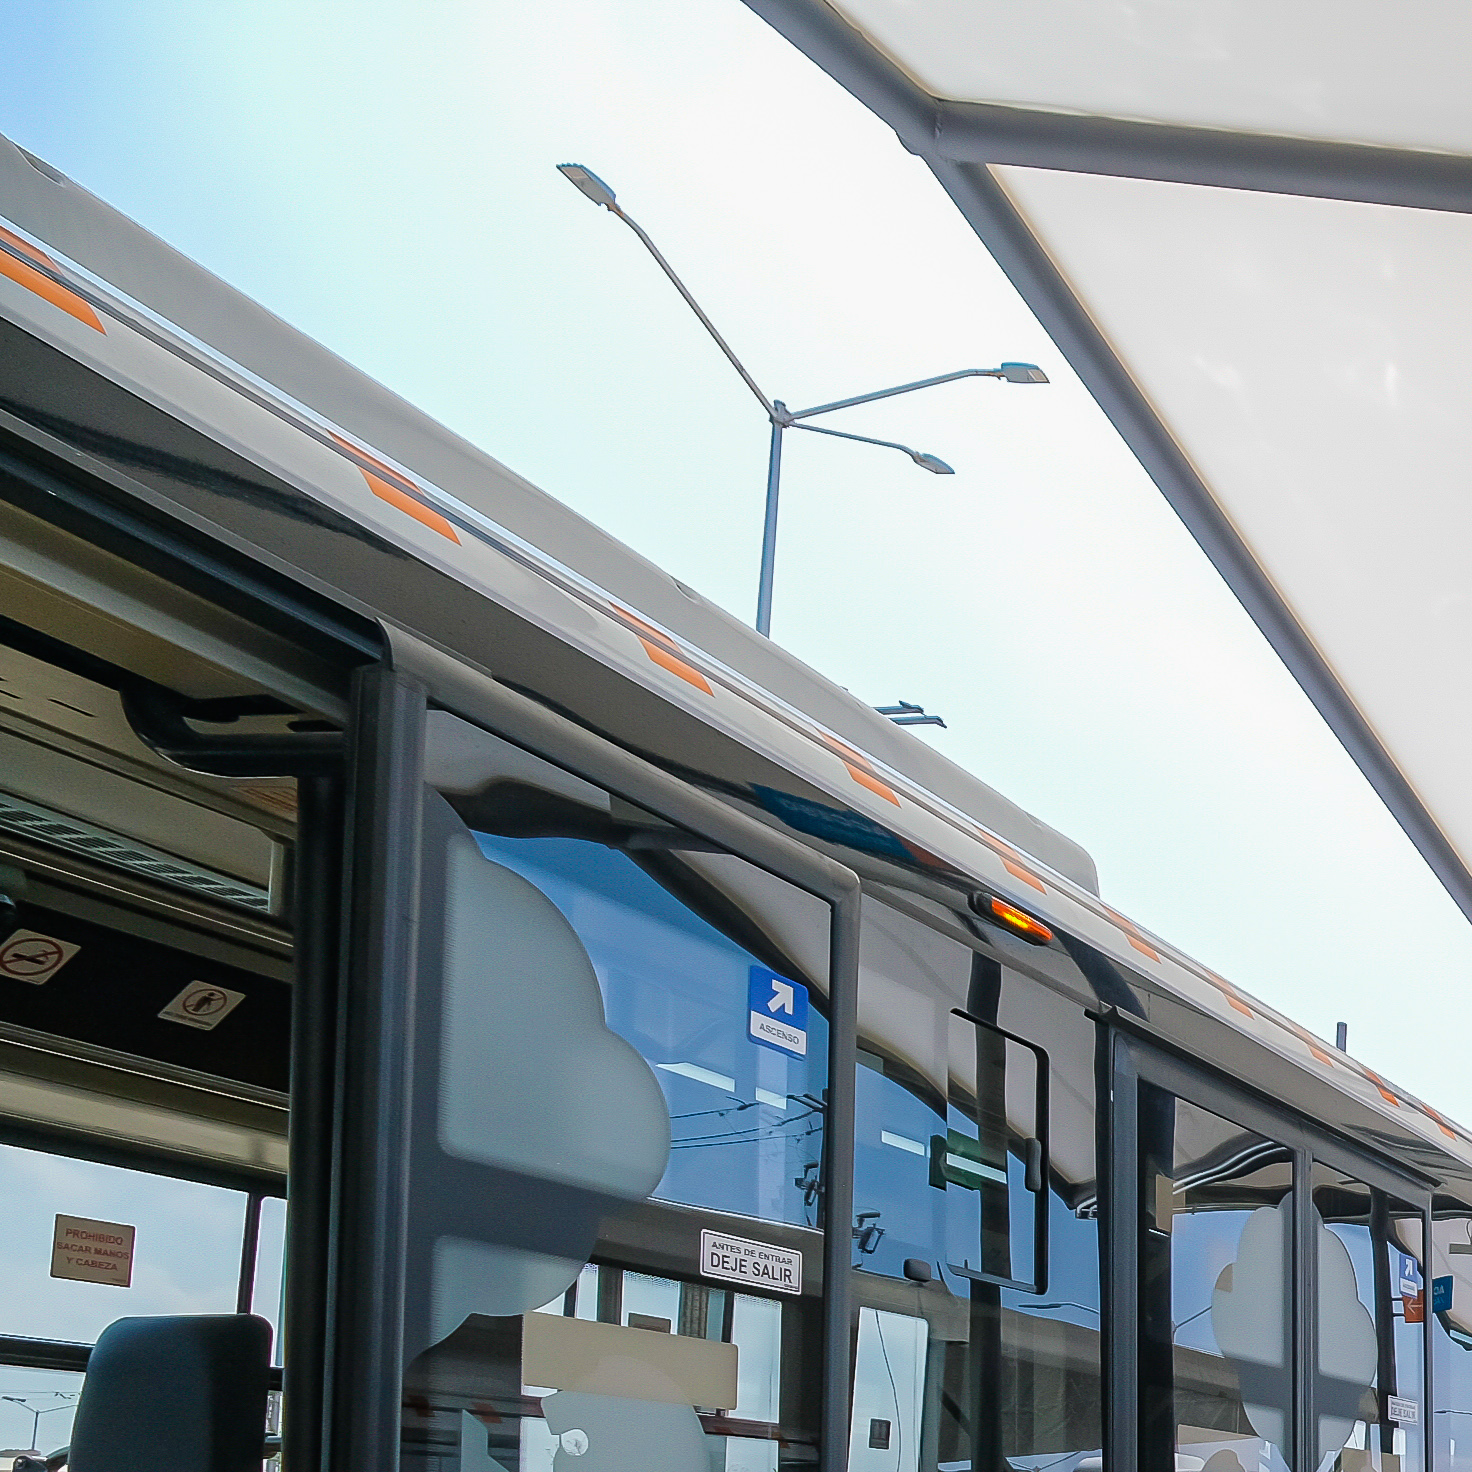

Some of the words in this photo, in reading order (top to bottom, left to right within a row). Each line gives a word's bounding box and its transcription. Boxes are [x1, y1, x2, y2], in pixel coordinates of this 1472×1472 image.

[760, 1023, 799, 1045] ASCENSO
[65, 1228, 123, 1246] PROHIBIDO
[57, 1242, 92, 1256] SACAR
[94, 1247, 130, 1260] MANOS
[712, 1241, 742, 1255] ANTES
[744, 1249, 756, 1258] DE
[758, 1252, 793, 1266] ENTRAR
[66, 1257, 74, 1265] Y
[76, 1258, 118, 1271] CABEZA
[711, 1252, 748, 1274] DEJE
[752, 1262, 793, 1284] SALIR
